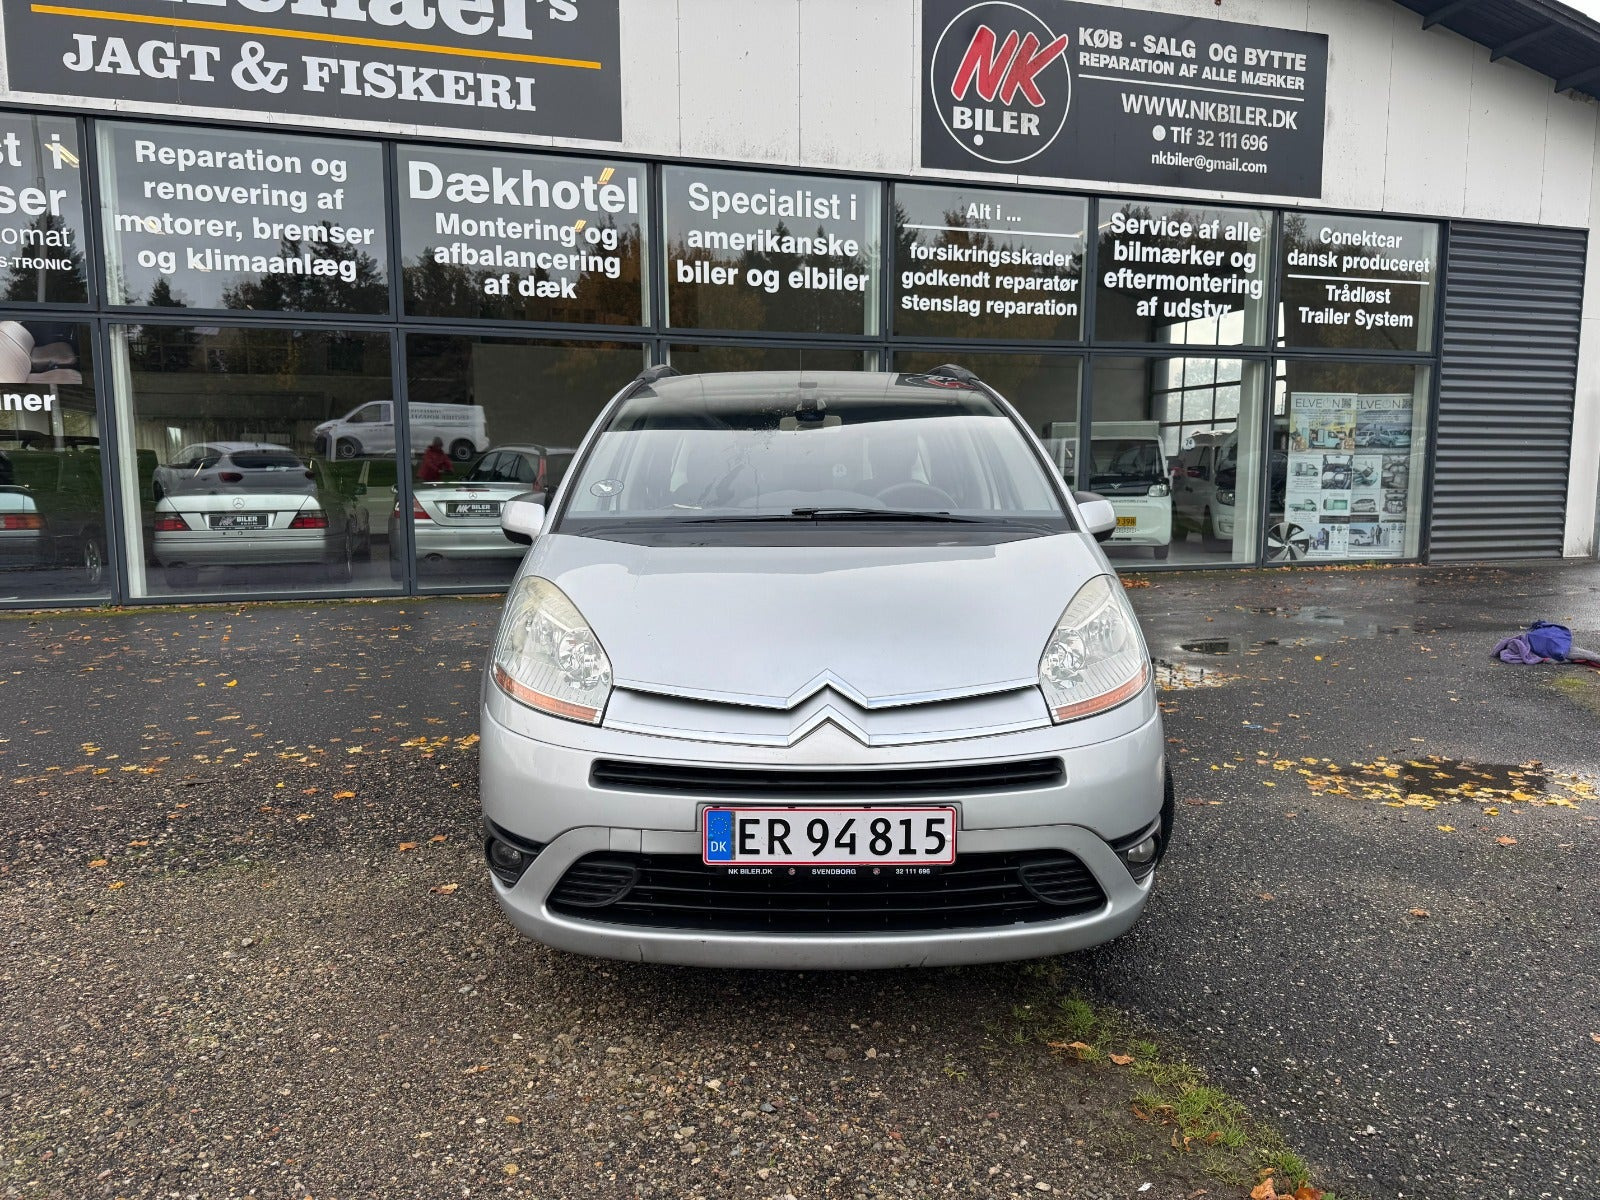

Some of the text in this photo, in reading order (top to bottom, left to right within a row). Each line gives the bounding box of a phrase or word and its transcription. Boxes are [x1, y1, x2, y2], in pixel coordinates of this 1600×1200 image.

[1078, 26, 1123, 50] KØB
[1143, 34, 1196, 59] SALG
[1208, 42, 1238, 64] OG
[1244, 47, 1307, 72] BYTTE
[62, 33, 537, 112] JAGT & FISKERI
[951, 24, 1069, 108] NK
[1079, 51, 1305, 91] REPARATION AF ALLE MÆRKER
[952, 105, 1040, 136] BILER
[1121, 92, 1298, 130] WWW.NKBILER.DK
[51, 133, 63, 170] i
[1170, 126, 1268, 152] Tlf 32 111 696
[135, 139, 348, 183] Reparation og
[1151, 150, 1268, 174] nkbiler@gmail.com
[144, 180, 345, 214] renovering af
[408, 160, 638, 214] Dækhotel
[688, 182, 857, 221] Specialist i
[965, 202, 991, 220] Alt
[996, 204, 1001, 220] i
[1110, 212, 1262, 243] Service af alle
[114, 212, 375, 245] motorer, bremser
[435, 212, 618, 250] Montering og
[687, 228, 859, 257] amerikanske
[1319, 227, 1403, 249] Conektcar
[137, 247, 357, 283] og klimaanlæg
[434, 242, 621, 279] afbalancering
[910, 242, 1073, 268] forsikringsskader
[1113, 240, 1257, 273] bilmærker og
[1287, 249, 1430, 273] dansk produceret
[484, 274, 577, 299] af dæk
[676, 259, 870, 294] biler og elbiler
[901, 269, 1079, 294] godkendt reparatør
[1103, 267, 1263, 300] eftermontering
[901, 294, 1078, 319] stenslag reparation
[1136, 296, 1232, 323] af udstyr
[1325, 283, 1391, 304] Trådløst
[1298, 306, 1413, 330] Trailer System
[0, 393, 56, 412] ner
[710, 841, 727, 852] DK
[738, 817, 946, 857] ER 94 815
